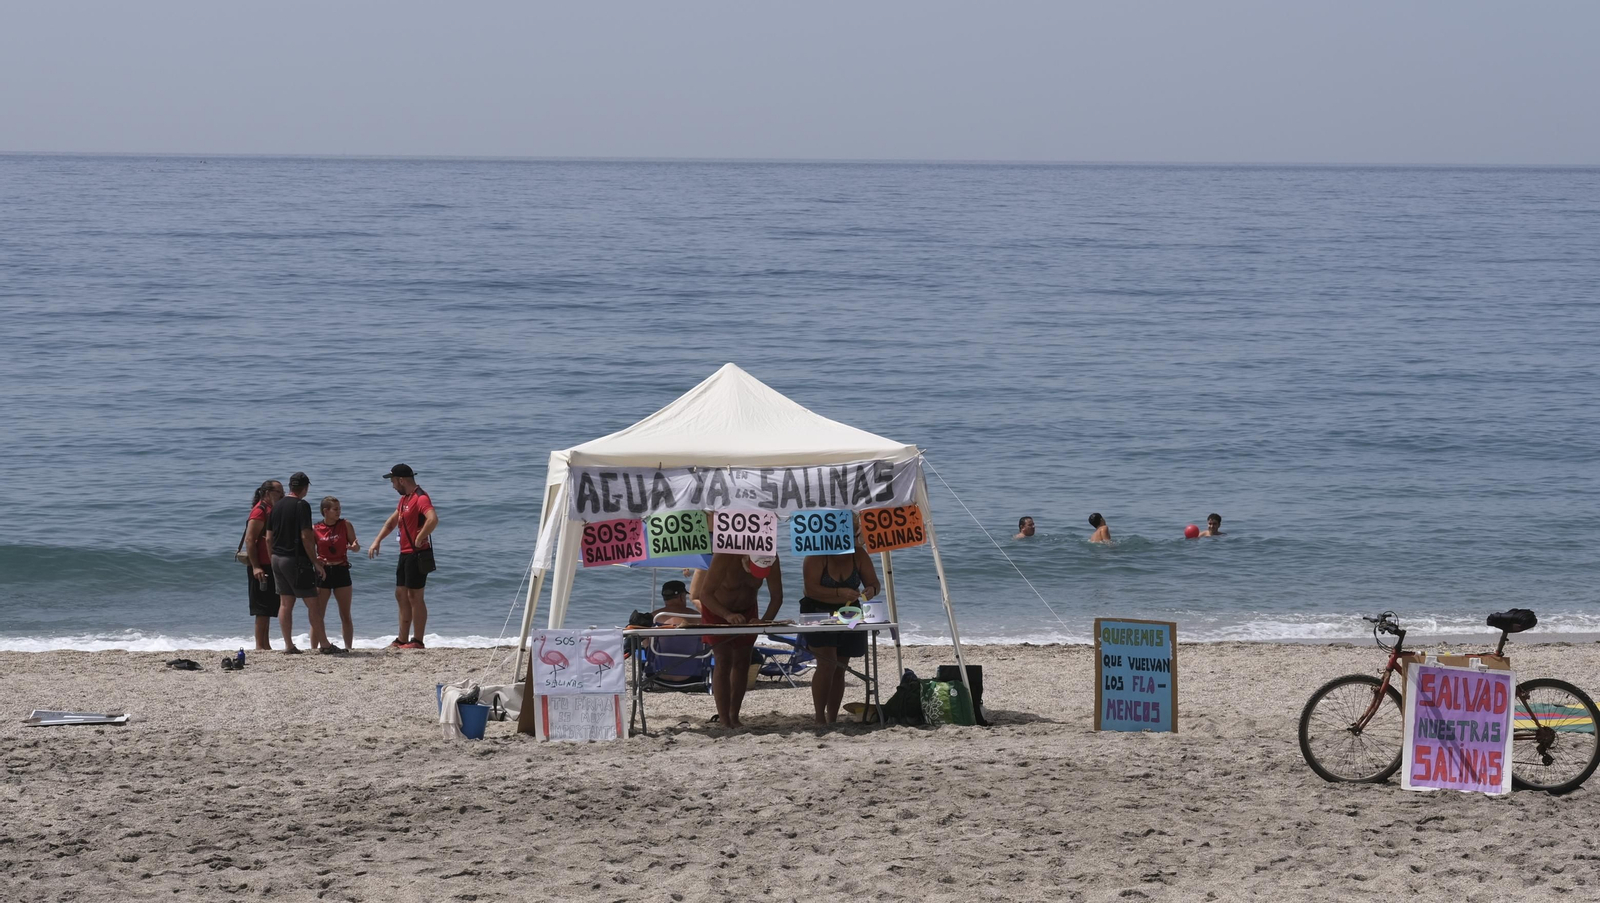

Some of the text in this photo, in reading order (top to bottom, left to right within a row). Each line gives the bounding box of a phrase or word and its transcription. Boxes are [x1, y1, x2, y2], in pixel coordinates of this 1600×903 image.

[735, 471, 749, 480] EN
[576, 460, 895, 514] AGUA YA SALINAS
[735, 489, 757, 499] LAS
[650, 513, 694, 536] SOS
[717, 512, 761, 533] SOS
[793, 512, 837, 534] SOS
[863, 506, 907, 532] SOS
[583, 522, 628, 545] SOS
[652, 534, 708, 554] SALINAS
[716, 533, 774, 552] SALINAS
[795, 534, 852, 552] SALINAS
[867, 526, 923, 549] SALINAS
[585, 541, 643, 563] SALINAS
[555, 636, 576, 646] SOS
[1102, 627, 1164, 647] QUEREMOS
[1103, 654, 1171, 673] QUE VUELVAN
[545, 679, 584, 689] SALINAS
[1105, 675, 1124, 691] LOS
[1419, 673, 1508, 714] SALVAD
[1105, 698, 1161, 723] MENCOS
[1417, 717, 1501, 743] NUESTRAS
[1412, 742, 1503, 786] SALINAS
